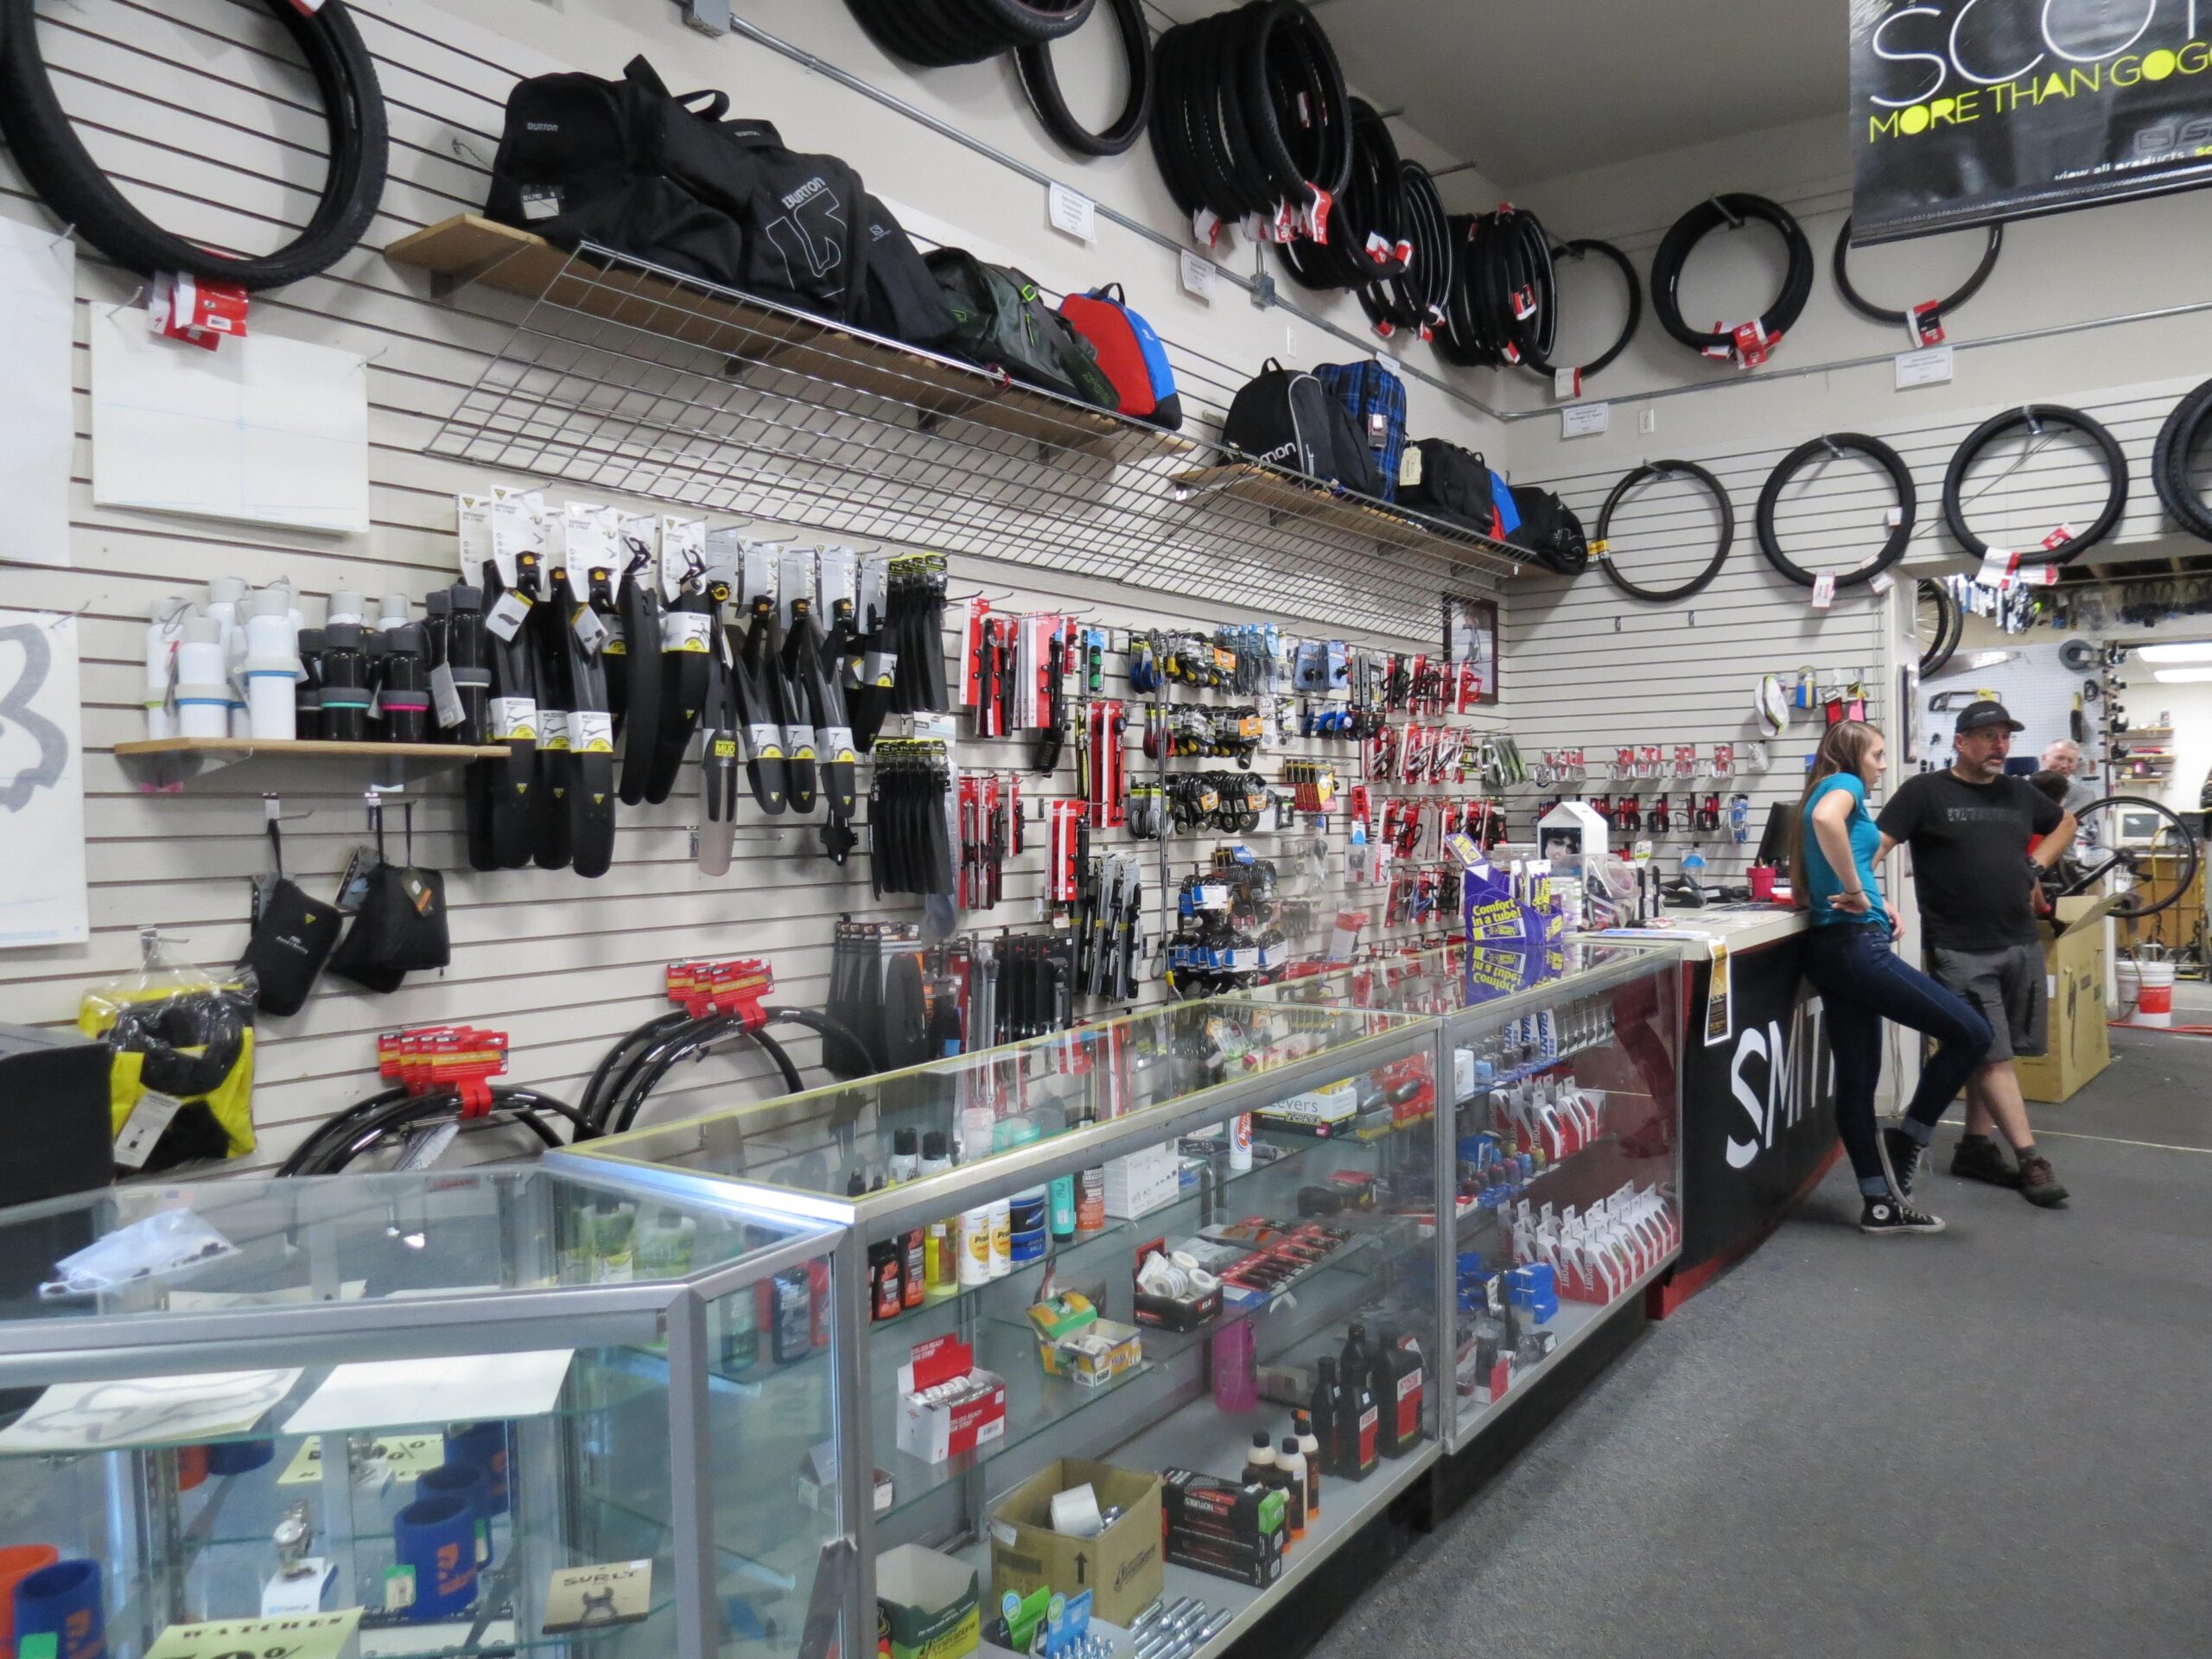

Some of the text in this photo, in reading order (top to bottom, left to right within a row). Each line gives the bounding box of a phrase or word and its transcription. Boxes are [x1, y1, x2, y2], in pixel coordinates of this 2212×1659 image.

[1870, 41, 2212, 143] MORE THAN GOG
[2093, 162, 2110, 175] all
[781, 176, 826, 210] BURTON
[715, 745, 735, 754] MUD
[1472, 898, 1516, 917] Comfort
[1472, 917, 1484, 927] in
[1493, 907, 1522, 921] tube!
[1540, 1012, 1548, 1058] GIANT
[1726, 995, 1835, 1169] SMIT
[1271, 1098, 1319, 1113] evers
[1585, 1262, 1593, 1291] SPORT
[563, 1569, 637, 1586] SURLY
[183, 1617, 343, 1639] WATCHES
